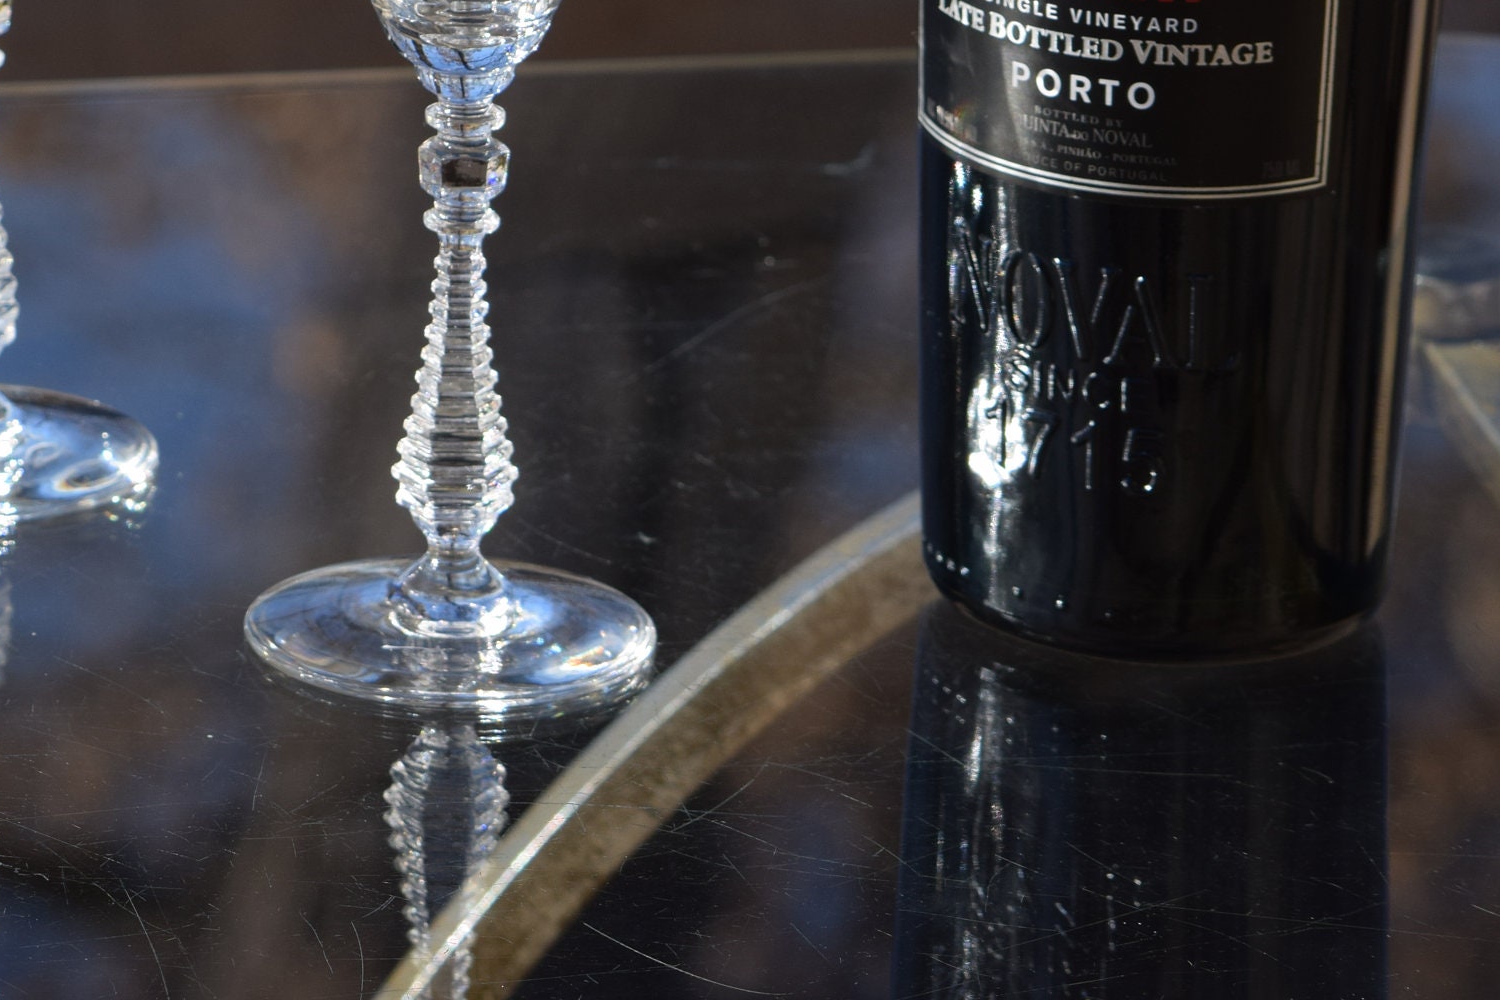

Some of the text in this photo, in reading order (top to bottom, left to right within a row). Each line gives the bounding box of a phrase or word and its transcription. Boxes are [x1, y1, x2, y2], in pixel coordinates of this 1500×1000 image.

[1069, 7, 1199, 34] VINEYARD
[989, 10, 1124, 63] BOTTLED
[1129, 38, 1275, 68] VINTAGE
[1011, 60, 1156, 111] PORTO
[1034, 104, 1100, 125] BOTTLED
[1092, 127, 1154, 149] NOVAL
